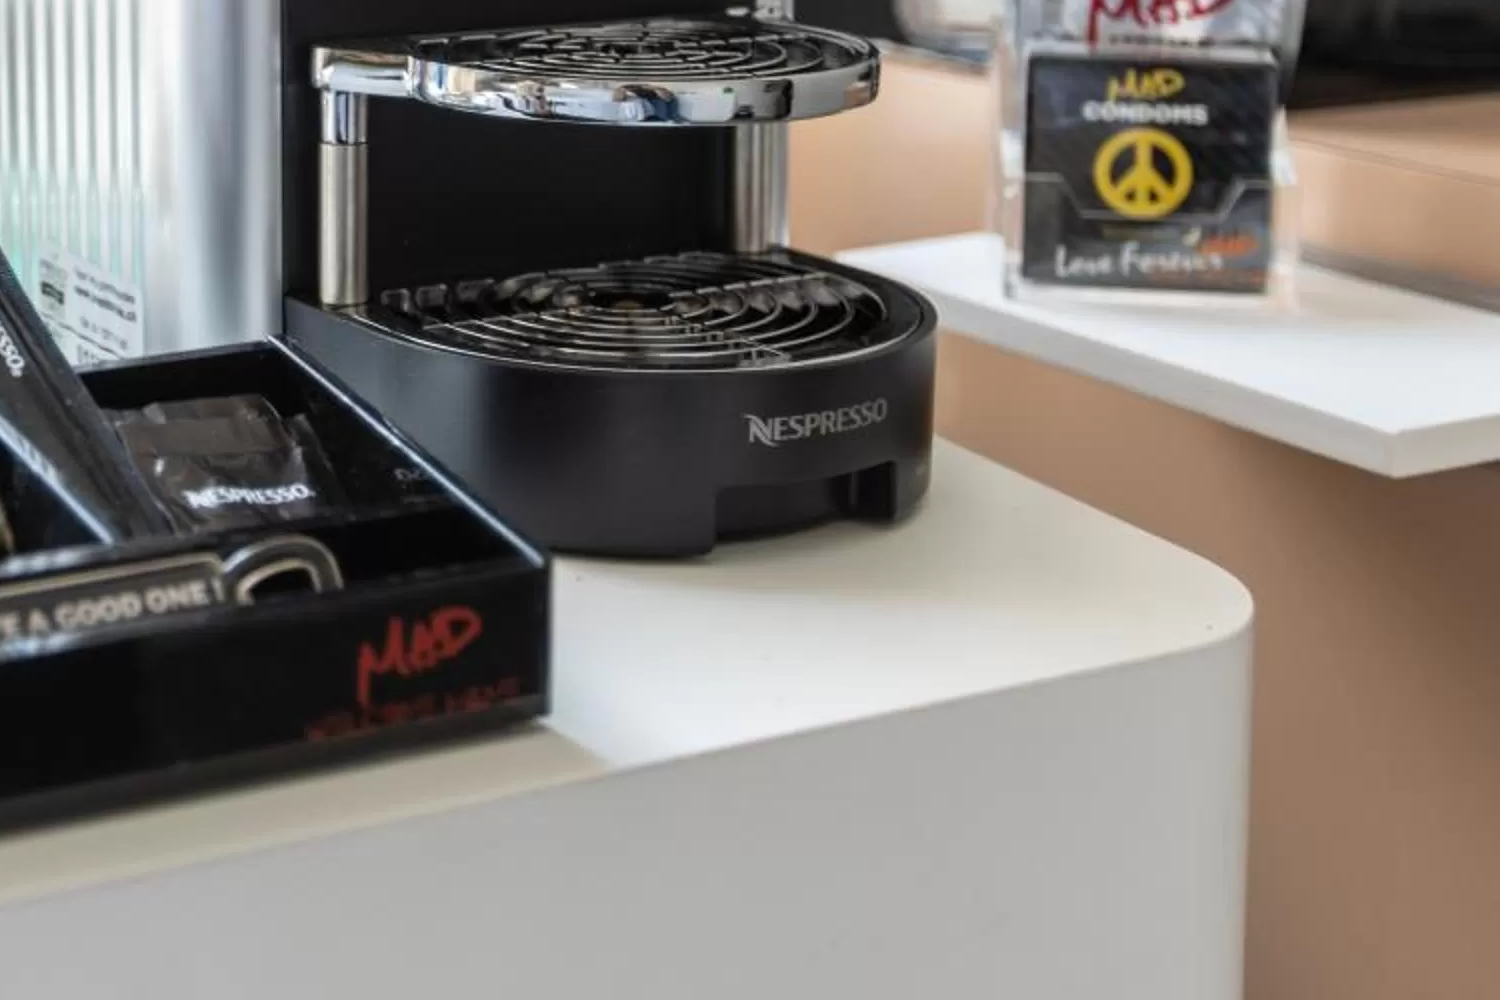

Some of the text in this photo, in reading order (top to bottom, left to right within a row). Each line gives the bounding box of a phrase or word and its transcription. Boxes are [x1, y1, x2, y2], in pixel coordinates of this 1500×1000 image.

[1106, 67, 1187, 105] MAD
[1080, 99, 1209, 127] CONDOMS
[741, 396, 888, 447] NESPRESSO
[182, 482, 311, 509] NESPRESSO
[27, 605, 50, 636] A
[53, 588, 141, 626] GOOD
[356, 603, 484, 710] MAD
